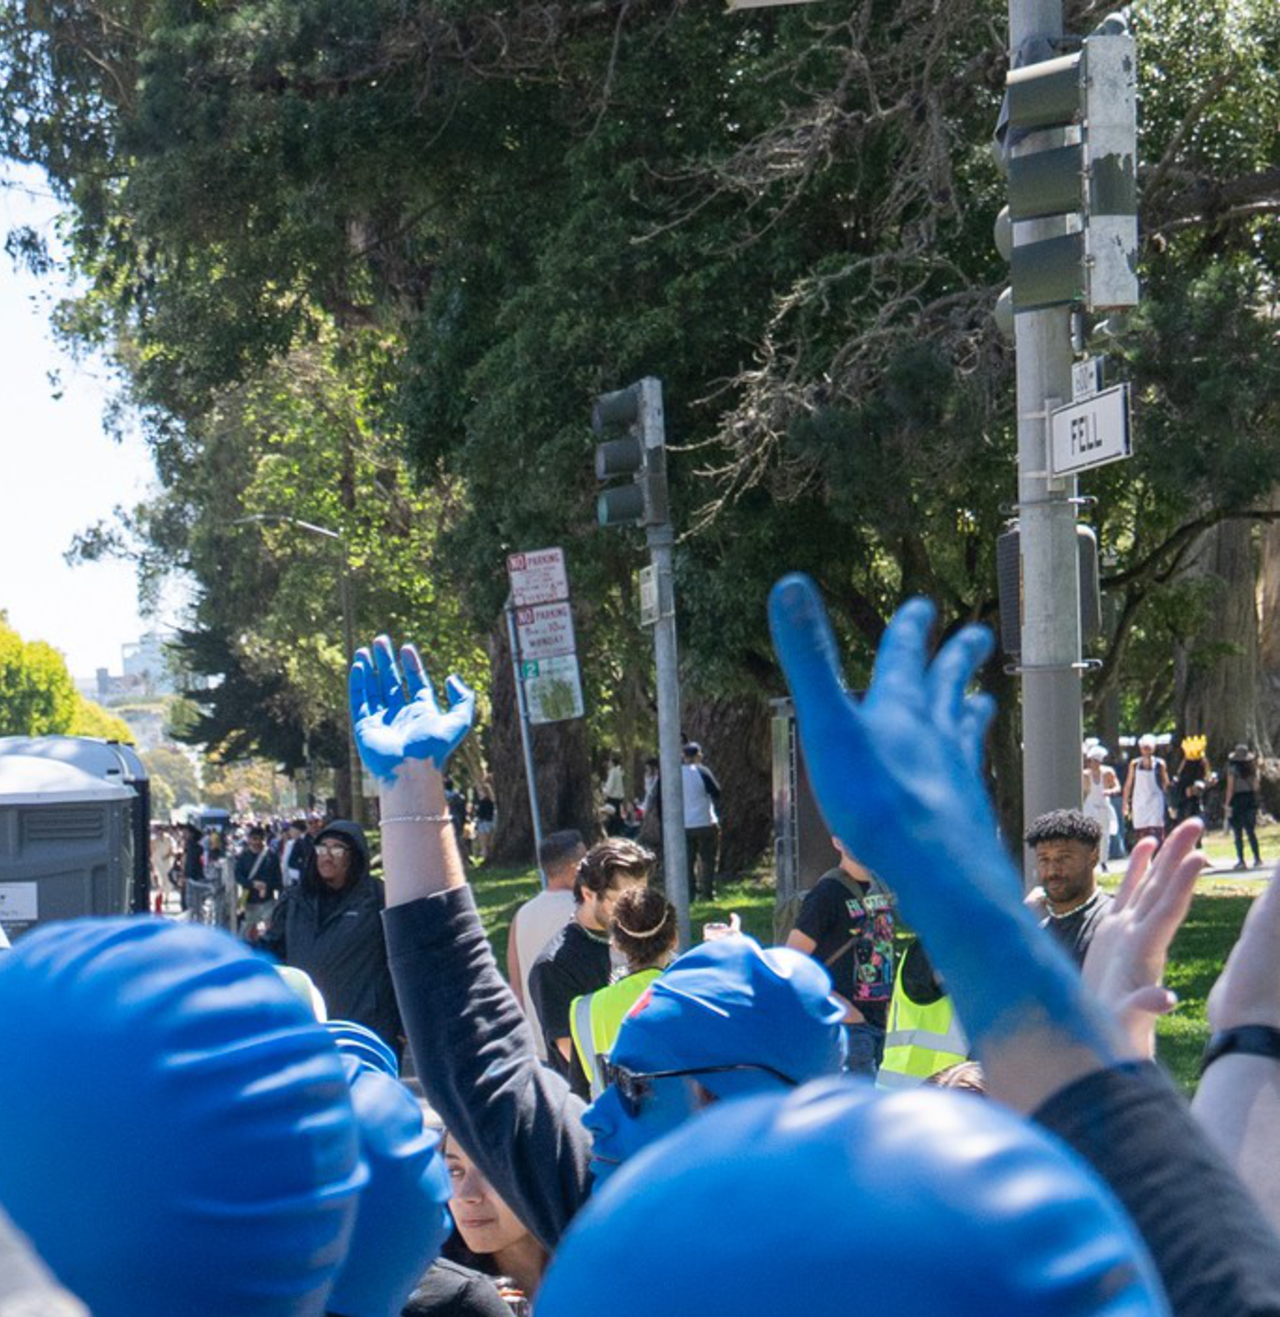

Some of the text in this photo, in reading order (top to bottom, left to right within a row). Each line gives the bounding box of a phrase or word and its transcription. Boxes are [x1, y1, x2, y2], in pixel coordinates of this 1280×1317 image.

[1071, 412, 1102, 456] FELL
[527, 552, 560, 567] PARKING
[535, 605, 567, 621] PARKING
[526, 664, 536, 675] 2
